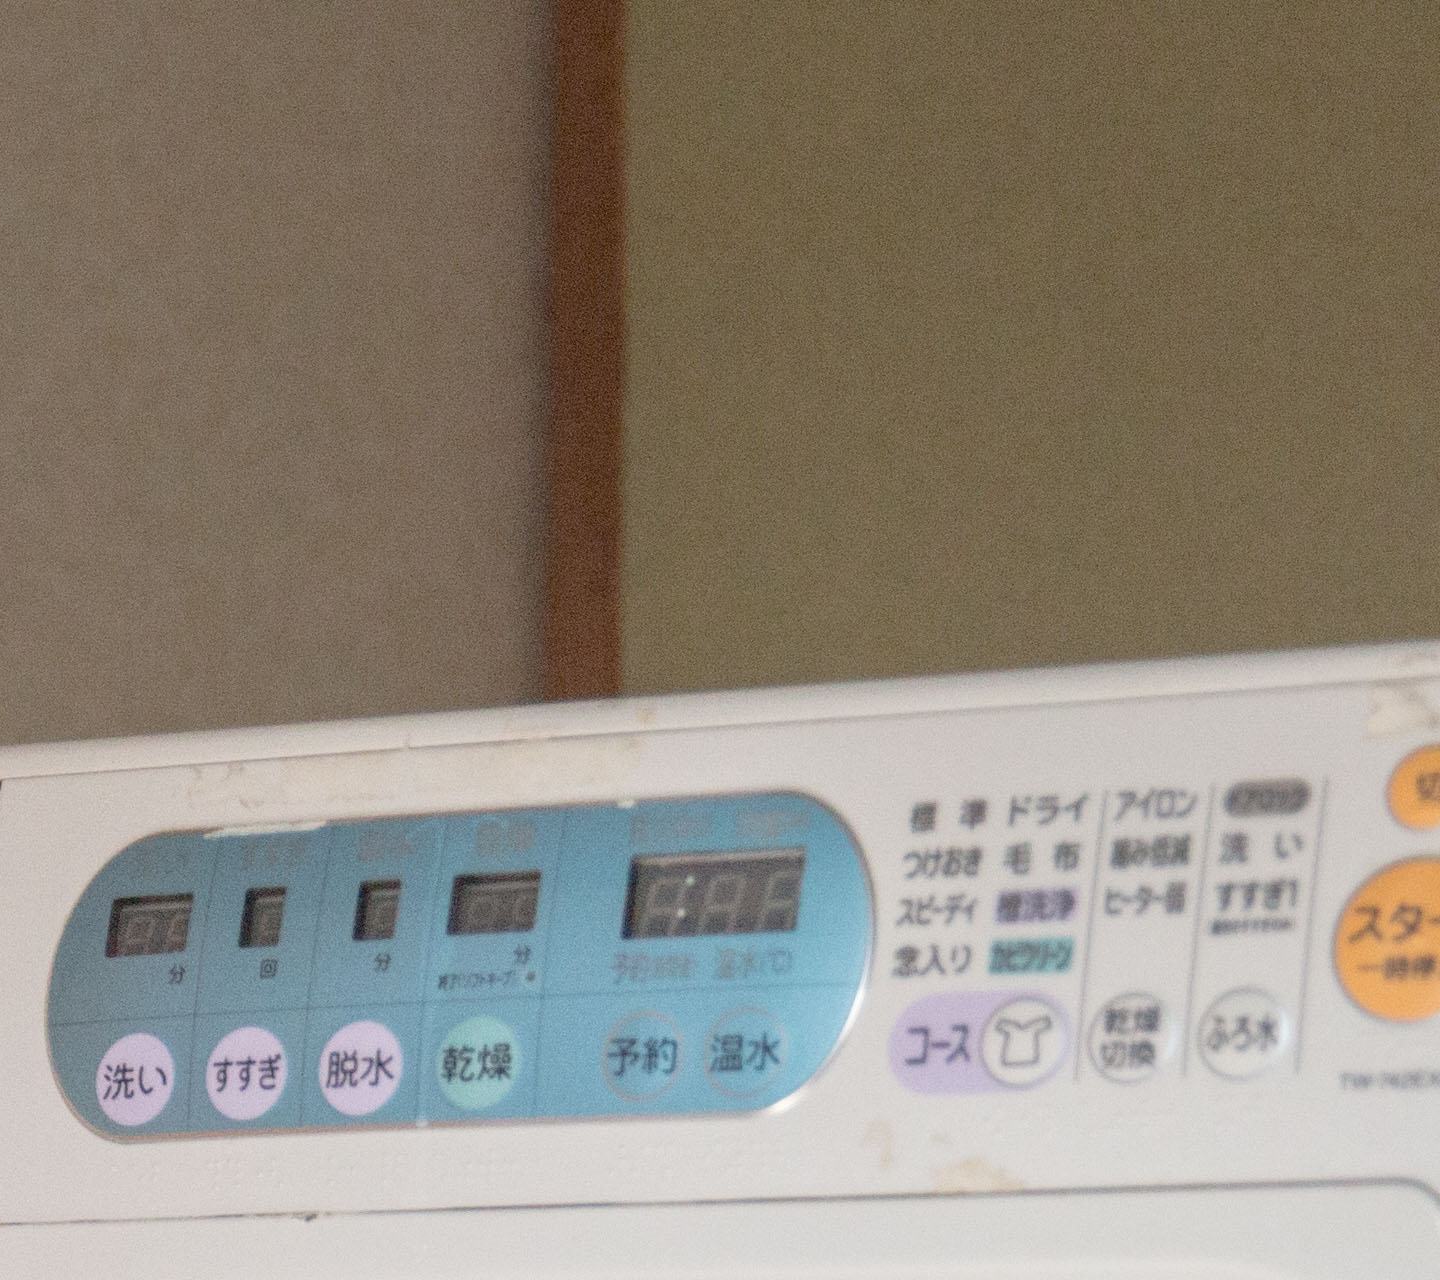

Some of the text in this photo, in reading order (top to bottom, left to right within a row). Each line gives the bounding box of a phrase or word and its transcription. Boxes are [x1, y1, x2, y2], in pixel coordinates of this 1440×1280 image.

[1008, 793, 1089, 826] ドライ
[1114, 787, 1198, 822] アイロン
[903, 846, 983, 880] つけおき
[168, 965, 186, 985] 分
[259, 958, 278, 979] 回
[373, 955, 391, 973] 分
[892, 945, 972, 978] 念入り
[905, 1024, 972, 1066] コース
[1206, 1015, 1279, 1053] ふろ水
[325, 1050, 395, 1090] 脱水
[441, 1042, 513, 1083] 乾燥
[607, 1036, 679, 1078] 予約
[709, 1033, 781, 1074] 温水
[102, 1063, 168, 1101] 洗い
[213, 1054, 282, 1093] すすぎ
